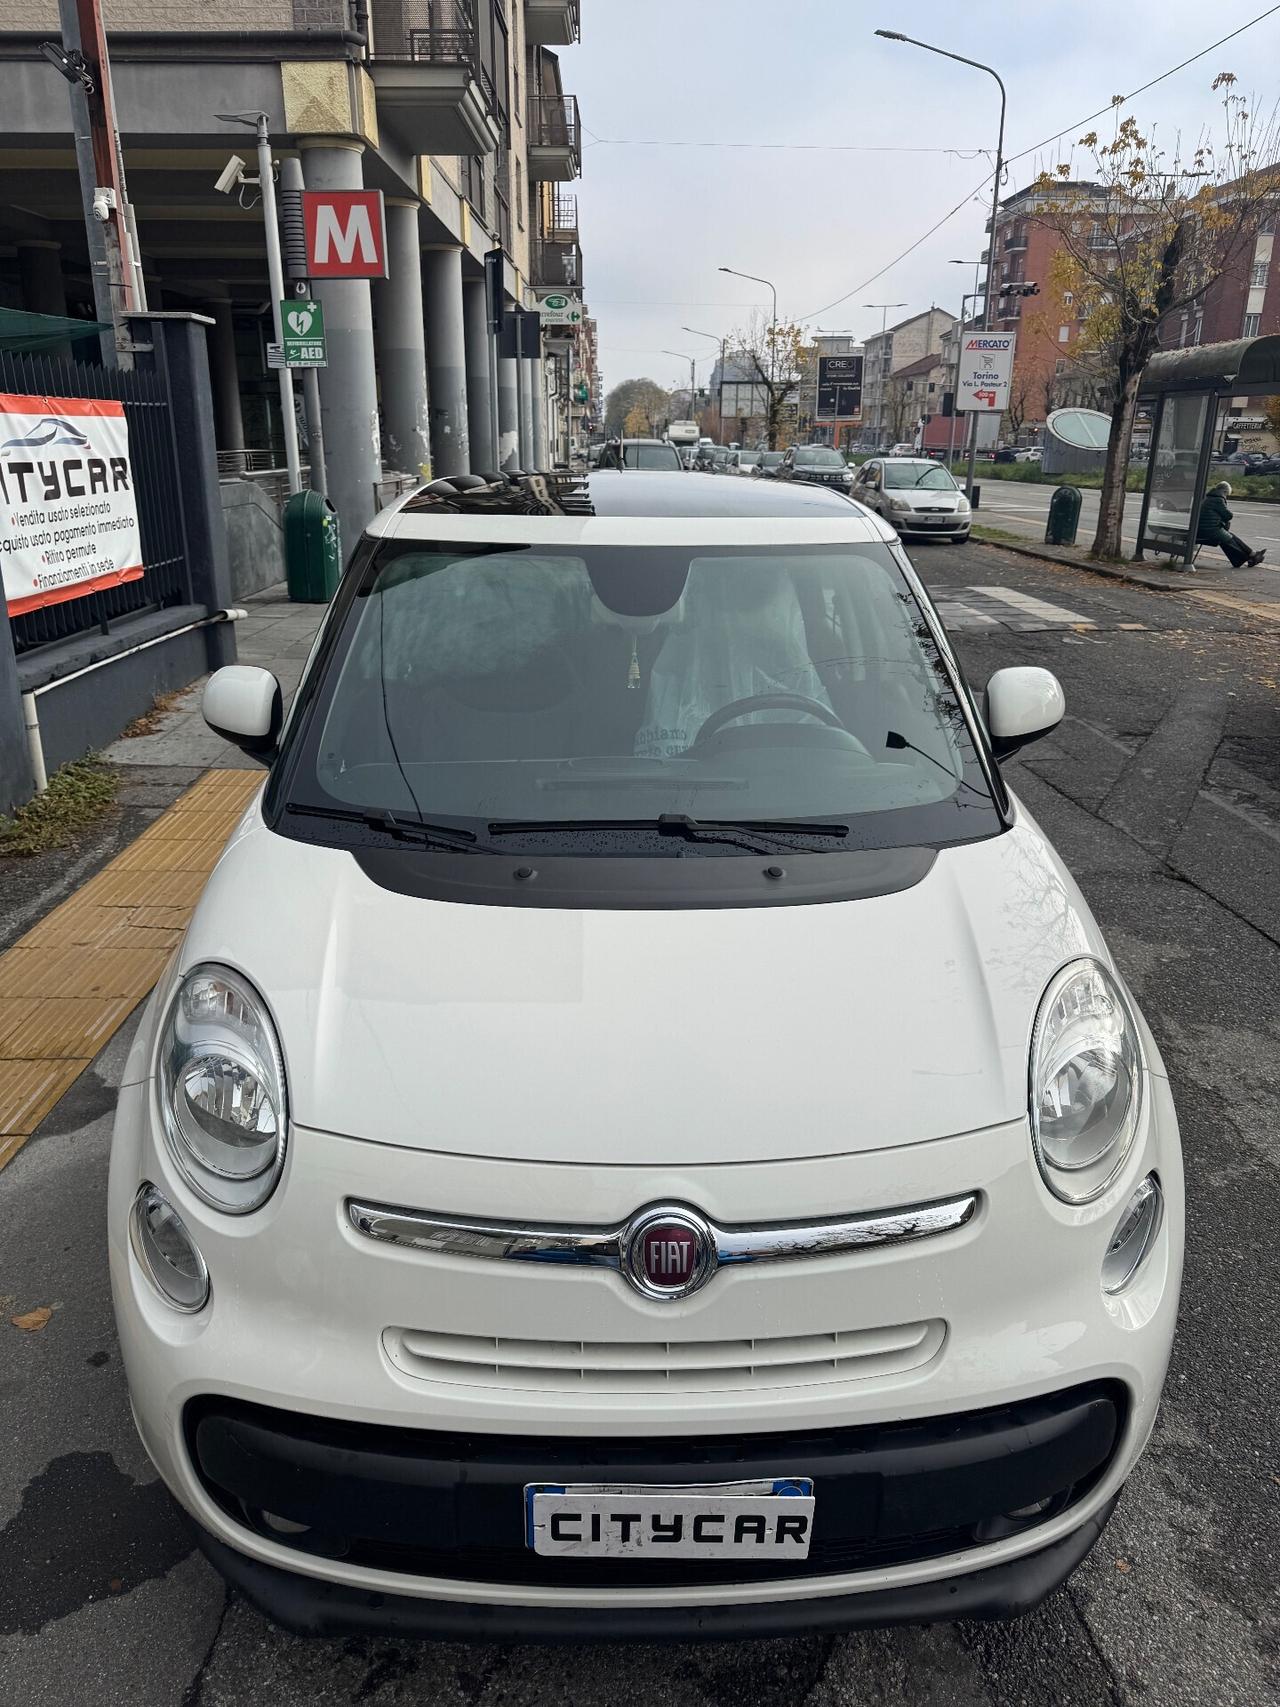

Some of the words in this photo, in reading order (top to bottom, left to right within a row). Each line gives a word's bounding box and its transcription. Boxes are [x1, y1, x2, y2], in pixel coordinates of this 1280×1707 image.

[314, 205, 378, 263] M
[301, 347, 323, 359] AED
[966, 340, 1009, 350] MERCATO
[973, 371, 999, 380] Torino
[0, 457, 130, 504] ITYCAR
[14, 510, 45, 527] Vendita
[48, 507, 69, 523] usato
[70, 502, 111, 519] selezionato
[30, 530, 52, 547] usato
[54, 525, 97, 546] pagamento
[97, 515, 134, 533] immediato
[45, 549, 64, 565] Ritiro
[66, 543, 97, 563] permute
[37, 565, 89, 588] Finanziamenti
[89, 562, 97, 575] in
[97, 558, 114, 572] sede
[650, 1241, 691, 1274] FIAT
[550, 1513, 808, 1544] CITYCAR
